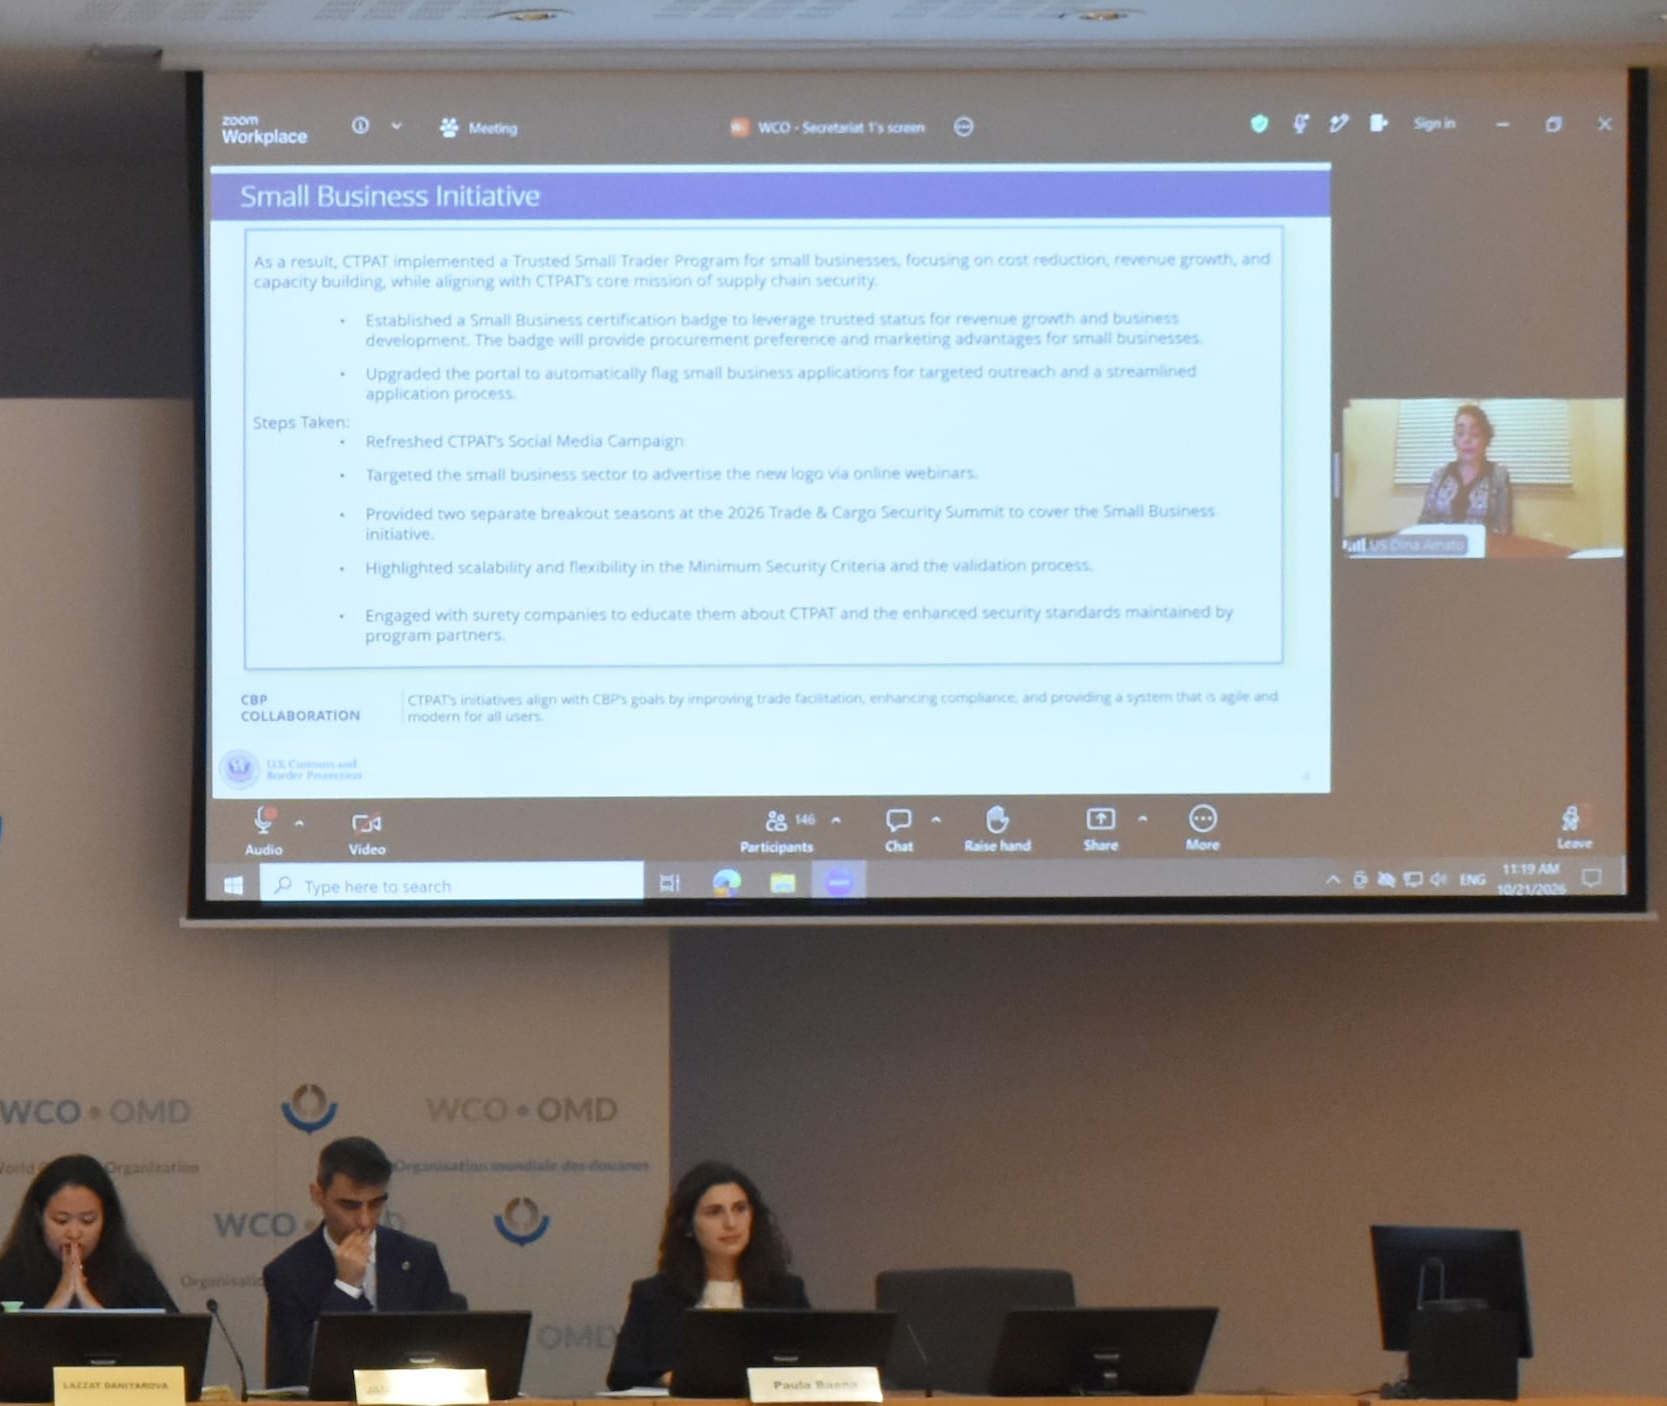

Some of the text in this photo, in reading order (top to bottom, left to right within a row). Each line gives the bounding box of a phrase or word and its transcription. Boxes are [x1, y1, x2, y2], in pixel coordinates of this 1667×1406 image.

[221, 115, 259, 130] zoom
[468, 121, 518, 138] Meeting
[1413, 116, 1456, 132] Sign in
[221, 128, 308, 147] Workplace
[240, 184, 541, 208] Small Business Initiative
[365, 312, 1179, 331] Established a Small Business certification badge to leverage trusted status for revenue growth and business
[240, 694, 267, 705] CBP
[240, 710, 360, 722] COLLABORATION
[794, 813, 816, 825] 146
[244, 844, 283, 855] Audio
[348, 843, 386, 856] Video
[739, 840, 814, 856] Participants
[1556, 838, 1593, 849] Leave
[1537, 863, 1560, 874] AM
[1459, 873, 1486, 886] ENG
[304, 879, 451, 897] Type here to search
[110, 1099, 191, 1124] OMD
[426, 1098, 618, 1123] WCO OMD
[105, 1161, 200, 1177] Organization
[393, 1159, 650, 1175] Organisation mondiale des douanes
[214, 1212, 297, 1238] WCO
[63, 1382, 100, 1390] LAZZAT
[773, 1381, 812, 1389] Paula
